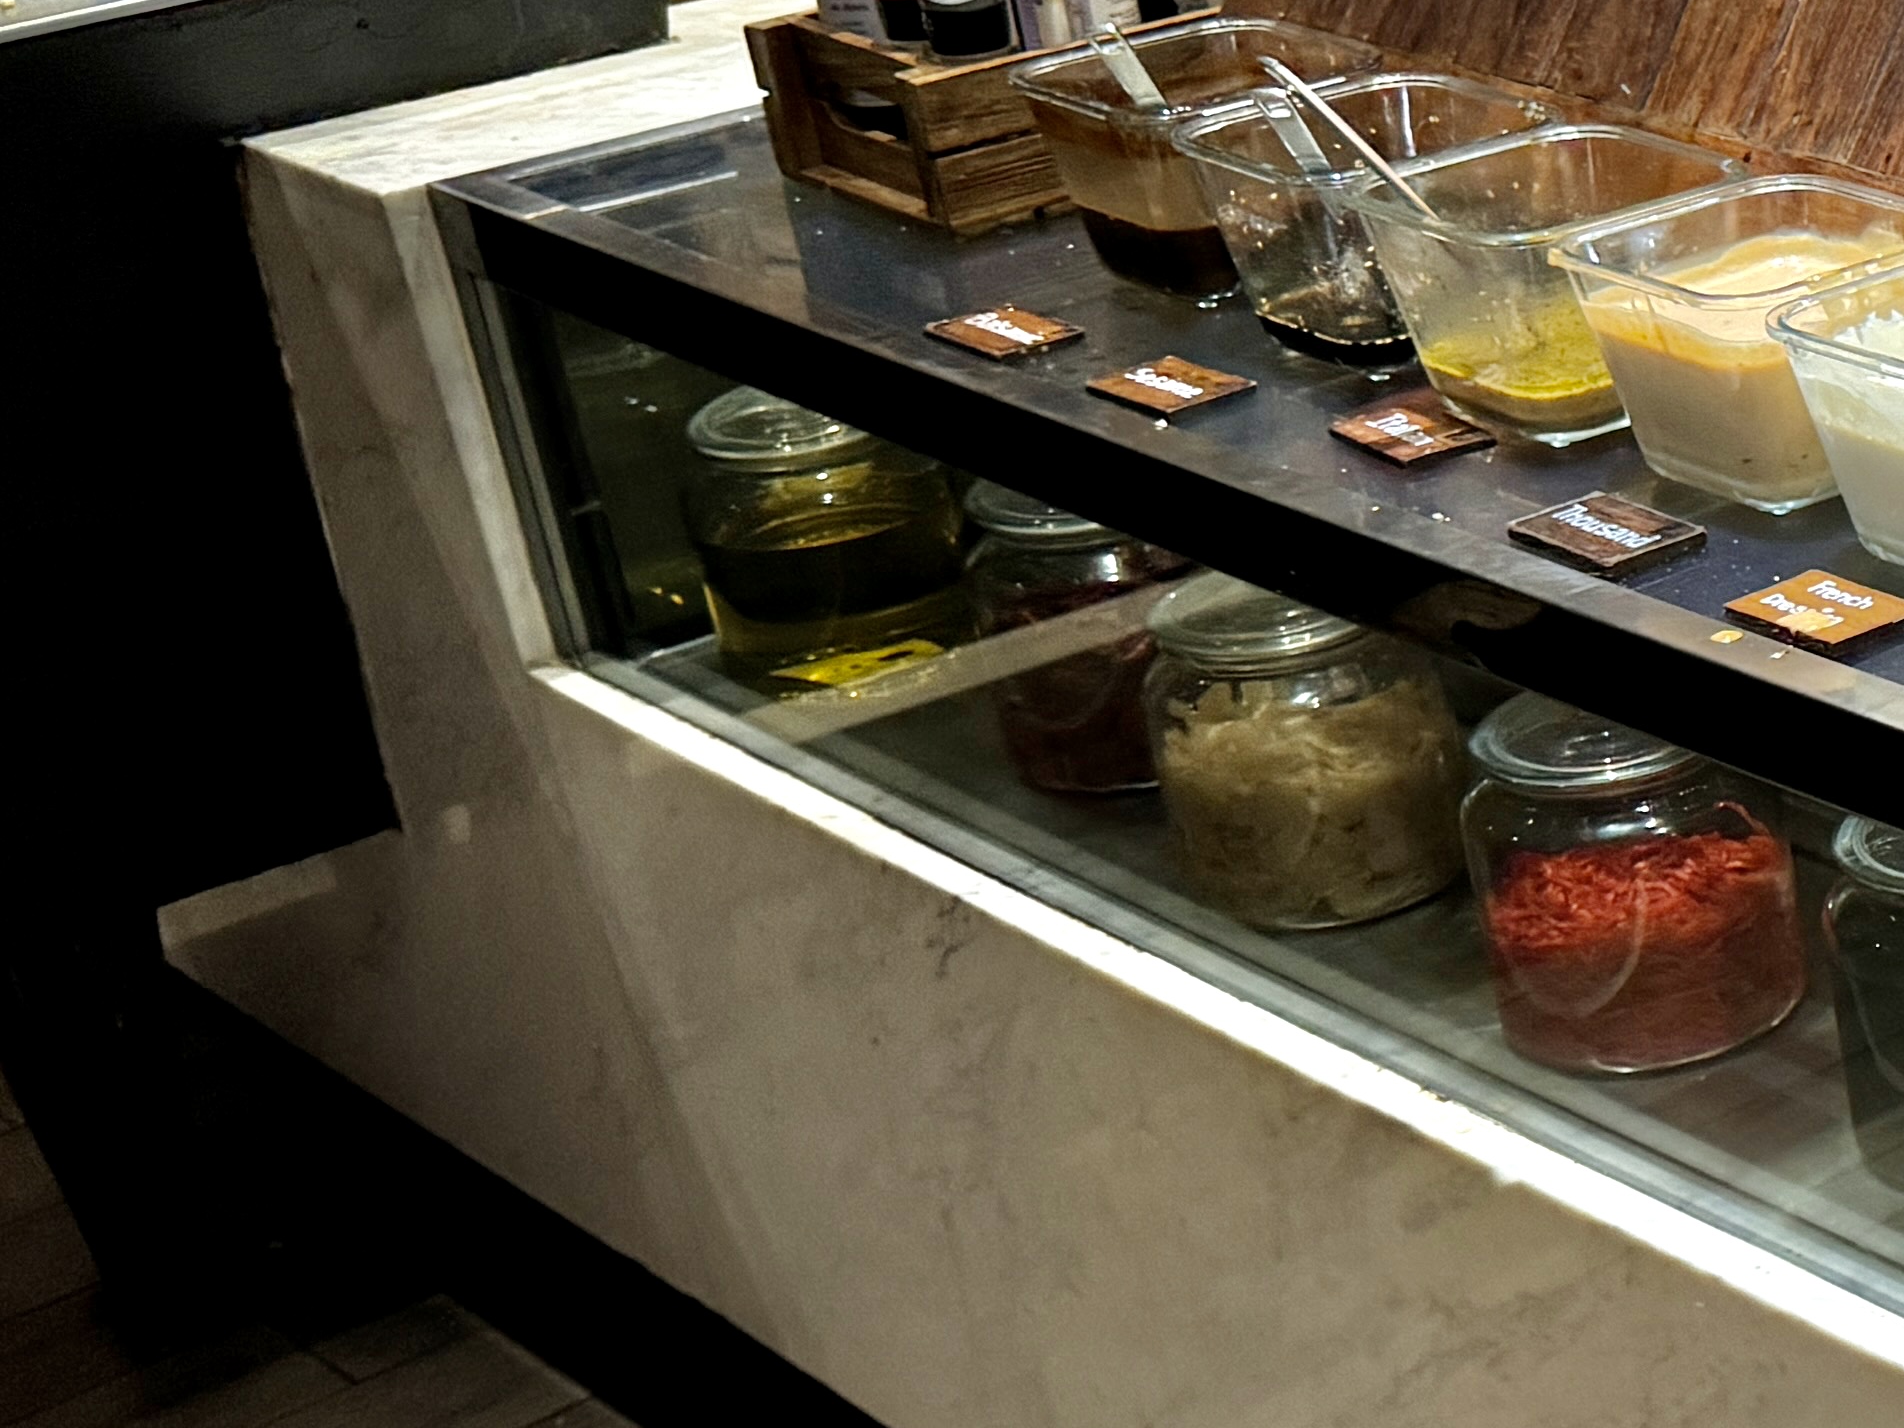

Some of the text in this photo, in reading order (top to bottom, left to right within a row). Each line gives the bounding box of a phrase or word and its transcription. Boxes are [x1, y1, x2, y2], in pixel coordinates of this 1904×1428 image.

[1551, 503, 1662, 549] Thousand
[1760, 593, 1844, 624] Dres
[1807, 580, 1874, 610] French
